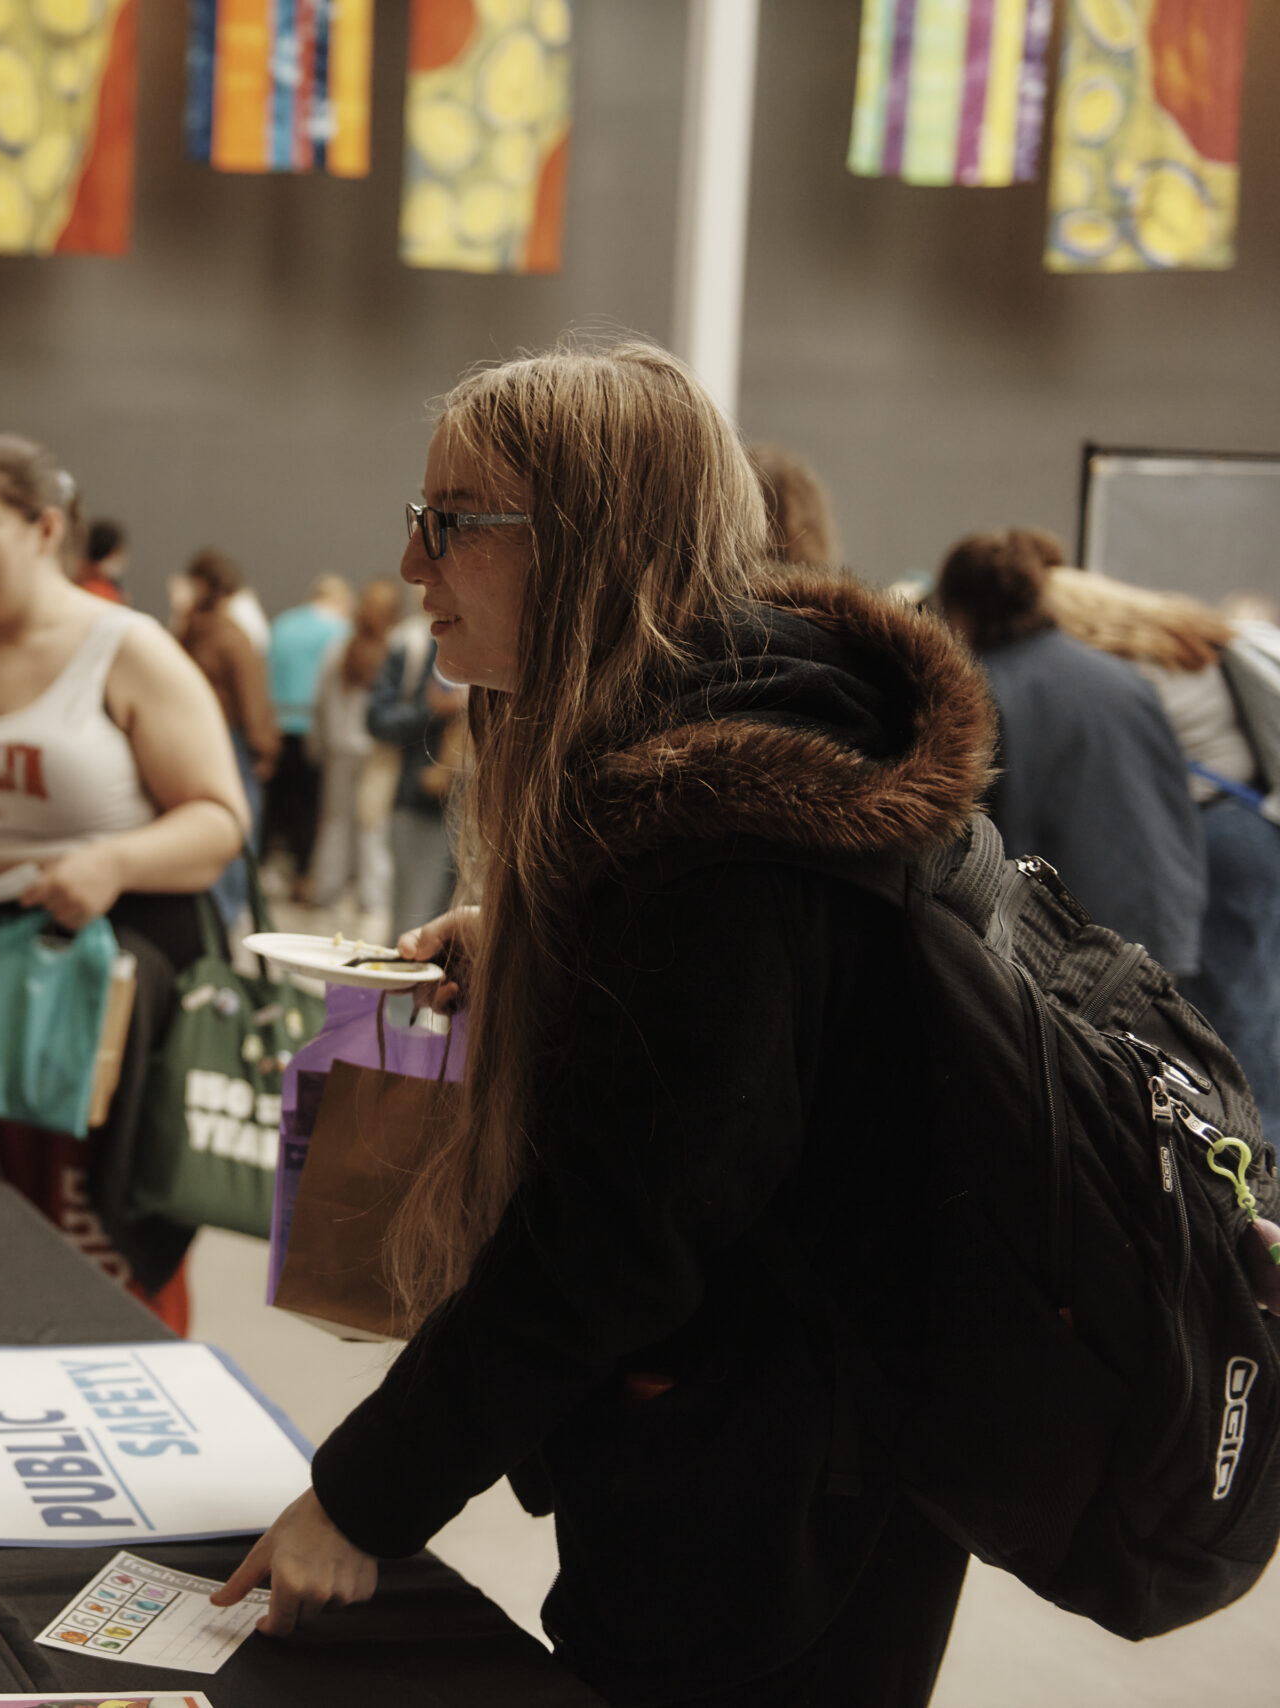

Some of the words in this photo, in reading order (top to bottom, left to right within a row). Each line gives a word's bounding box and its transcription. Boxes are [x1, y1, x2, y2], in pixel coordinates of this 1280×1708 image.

[58, 1360, 200, 1457] SAFETY
[1212, 1355, 1260, 1500] OGIO
[72, 1614, 99, 1628] 9
